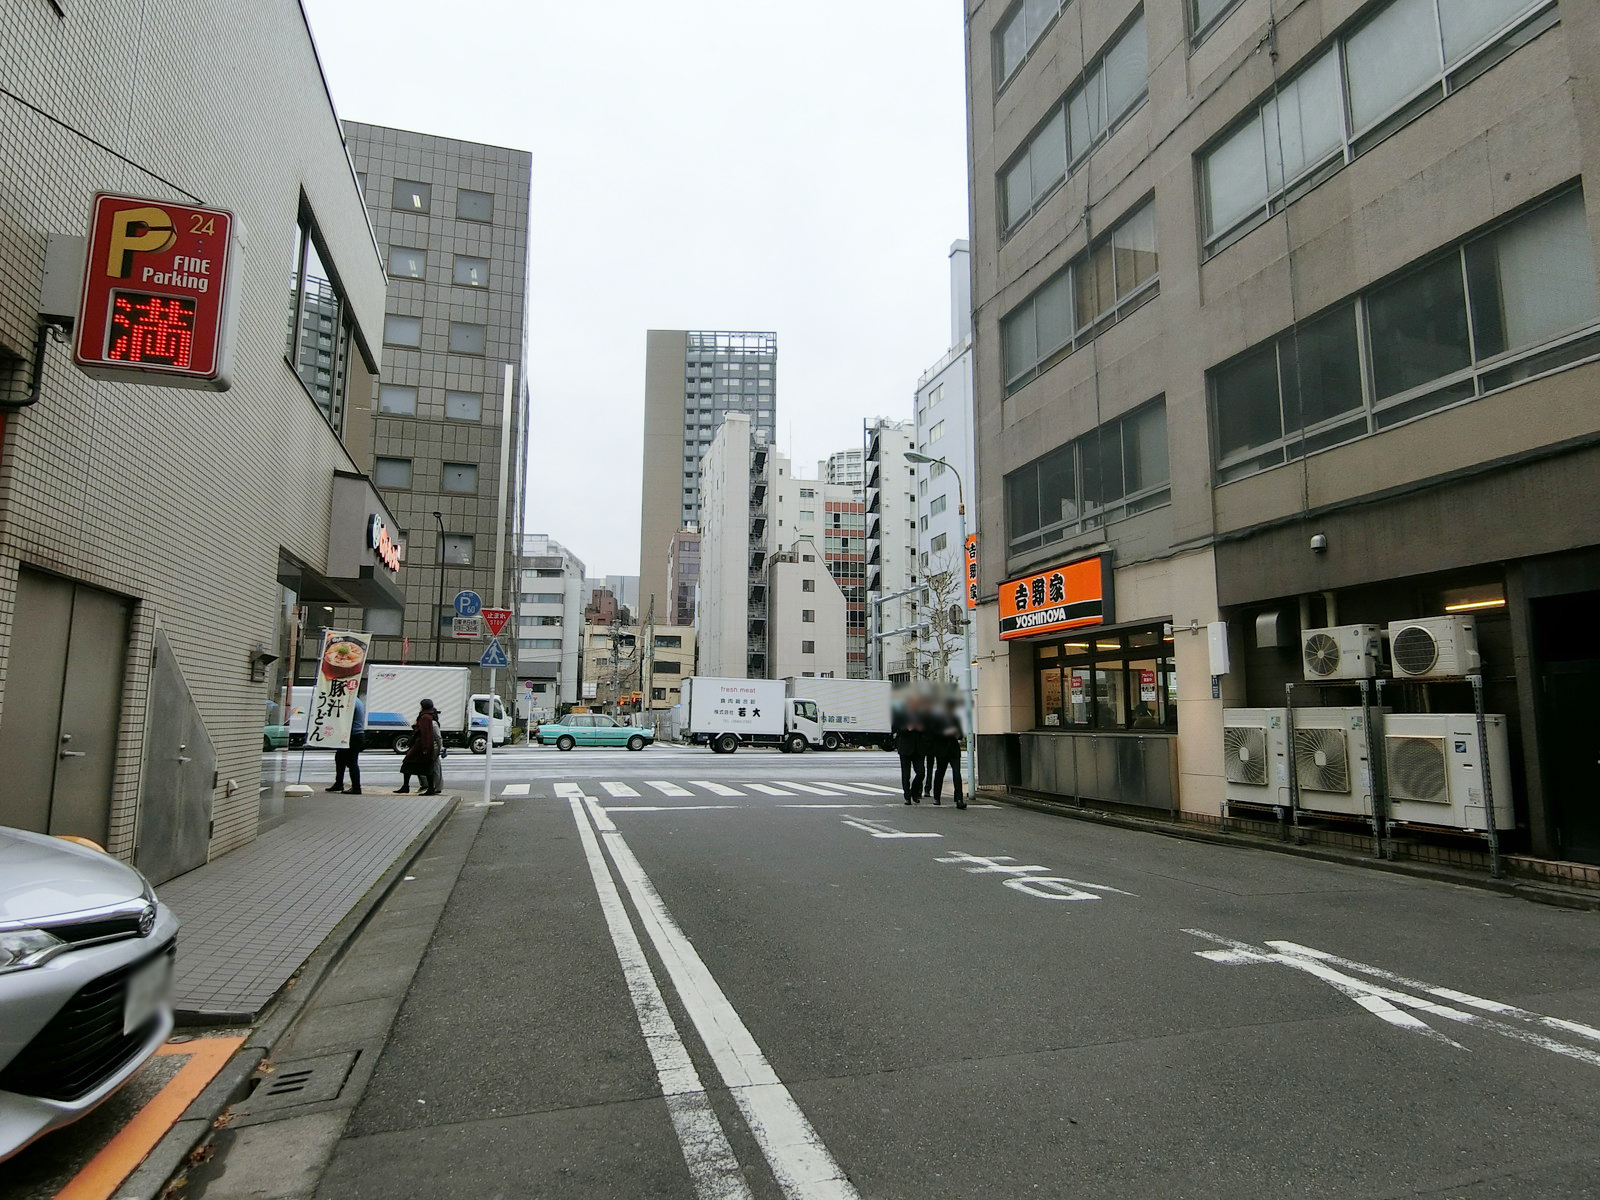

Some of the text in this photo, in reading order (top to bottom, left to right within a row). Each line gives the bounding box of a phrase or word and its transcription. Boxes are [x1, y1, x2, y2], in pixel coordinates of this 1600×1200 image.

[189, 213, 216, 237] 24
[107, 207, 178, 278] P
[173, 255, 211, 275] FINE
[142, 267, 210, 293] Parking
[110, 298, 194, 367] 満
[459, 596, 471, 613] P
[1014, 572, 1066, 611] 吉野家
[1015, 606, 1067, 629] YOSHINOYA
[327, 679, 348, 718] 豚汁
[309, 691, 328, 742] うどん
[738, 707, 761, 718] 若大
